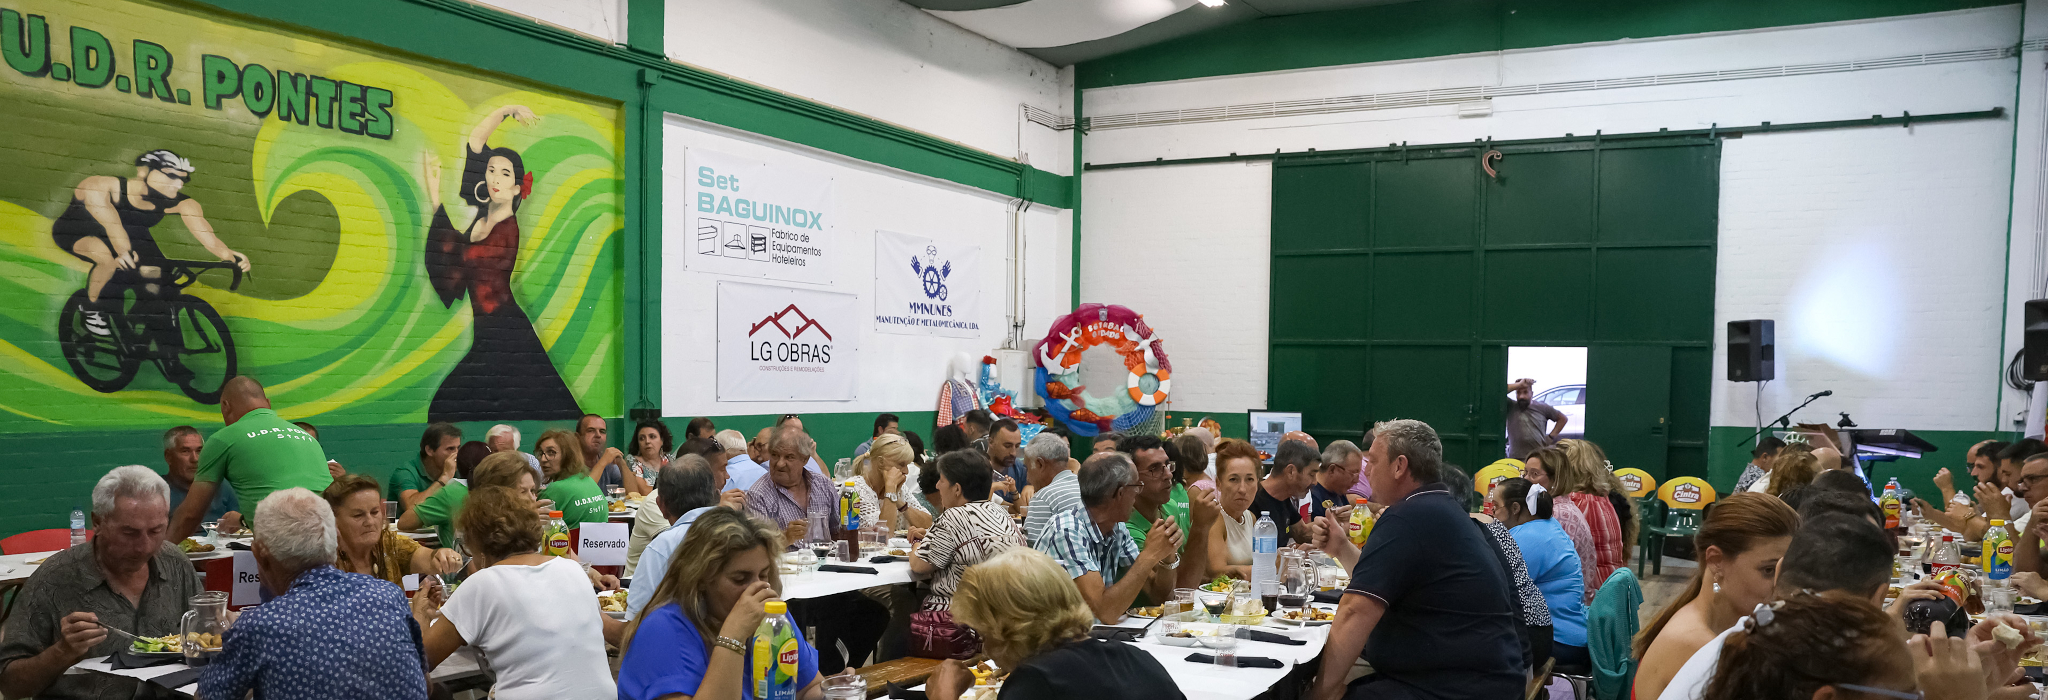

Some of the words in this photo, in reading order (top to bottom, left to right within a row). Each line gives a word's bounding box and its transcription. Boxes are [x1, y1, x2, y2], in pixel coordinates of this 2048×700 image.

[0, 7, 192, 105] U.D.R.
[202, 54, 394, 140] PONTES
[698, 166, 740, 192] Set
[698, 192, 823, 231] BAGUINOX
[772, 228, 798, 242] Fabrico
[800, 233, 810, 243] de
[772, 241, 822, 256] Equipamentos
[772, 253, 806, 267] Hoteleiros
[909, 302, 952, 317] MMNUNES
[876, 316, 915, 327] MANUTENÇÃO
[751, 341, 772, 361] LG
[778, 343, 831, 363] OBRAS
[247, 427, 284, 438] U.D.R.
[1624, 480, 1641, 488] intra
[1674, 491, 1700, 499] Cintra
[583, 539, 626, 548] Reservado
[239, 572, 260, 583] Res
